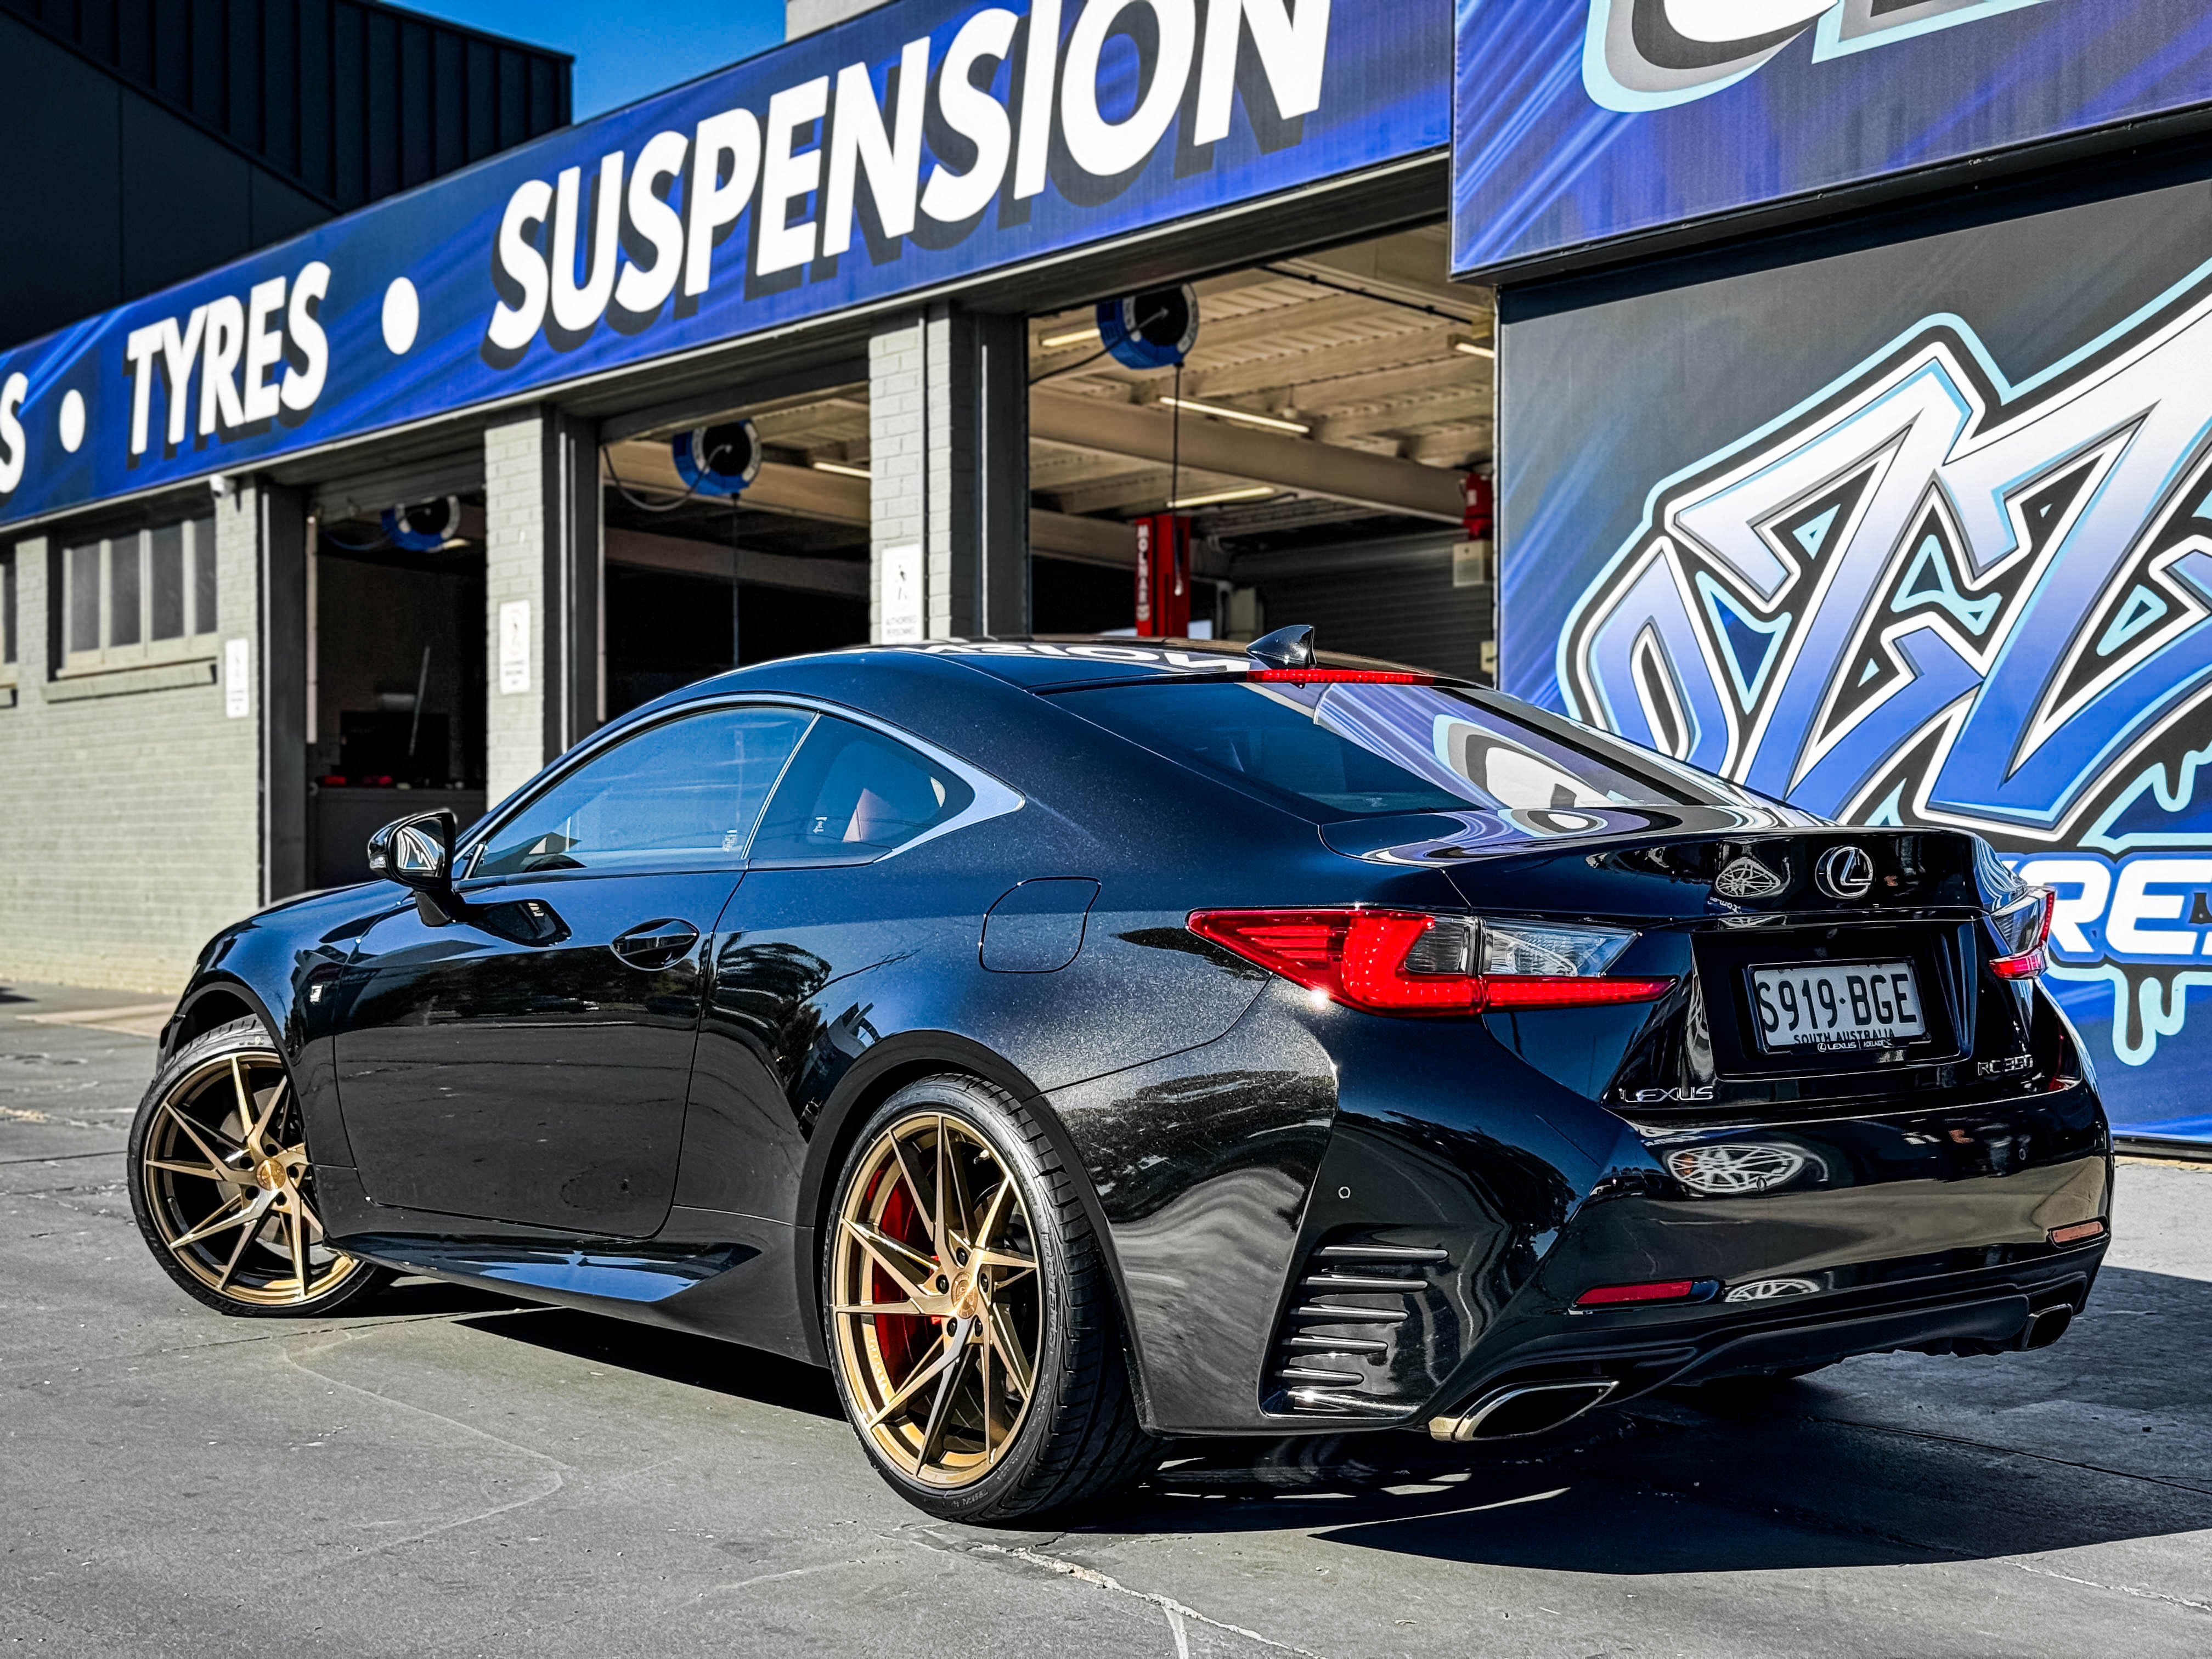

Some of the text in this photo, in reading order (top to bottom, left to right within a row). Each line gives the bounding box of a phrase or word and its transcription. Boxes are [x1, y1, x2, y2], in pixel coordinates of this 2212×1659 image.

[127, 261, 331, 455] TYRES
[487, 0, 1331, 350] SUSPENSION
[1793, 1028, 1895, 1045] SOUTH AUSTRALIA
[1827, 1042, 1857, 1050] LEXUS
[1977, 1054, 2033, 1076] RC 350
[1618, 1086, 1714, 1103] LEXUS
